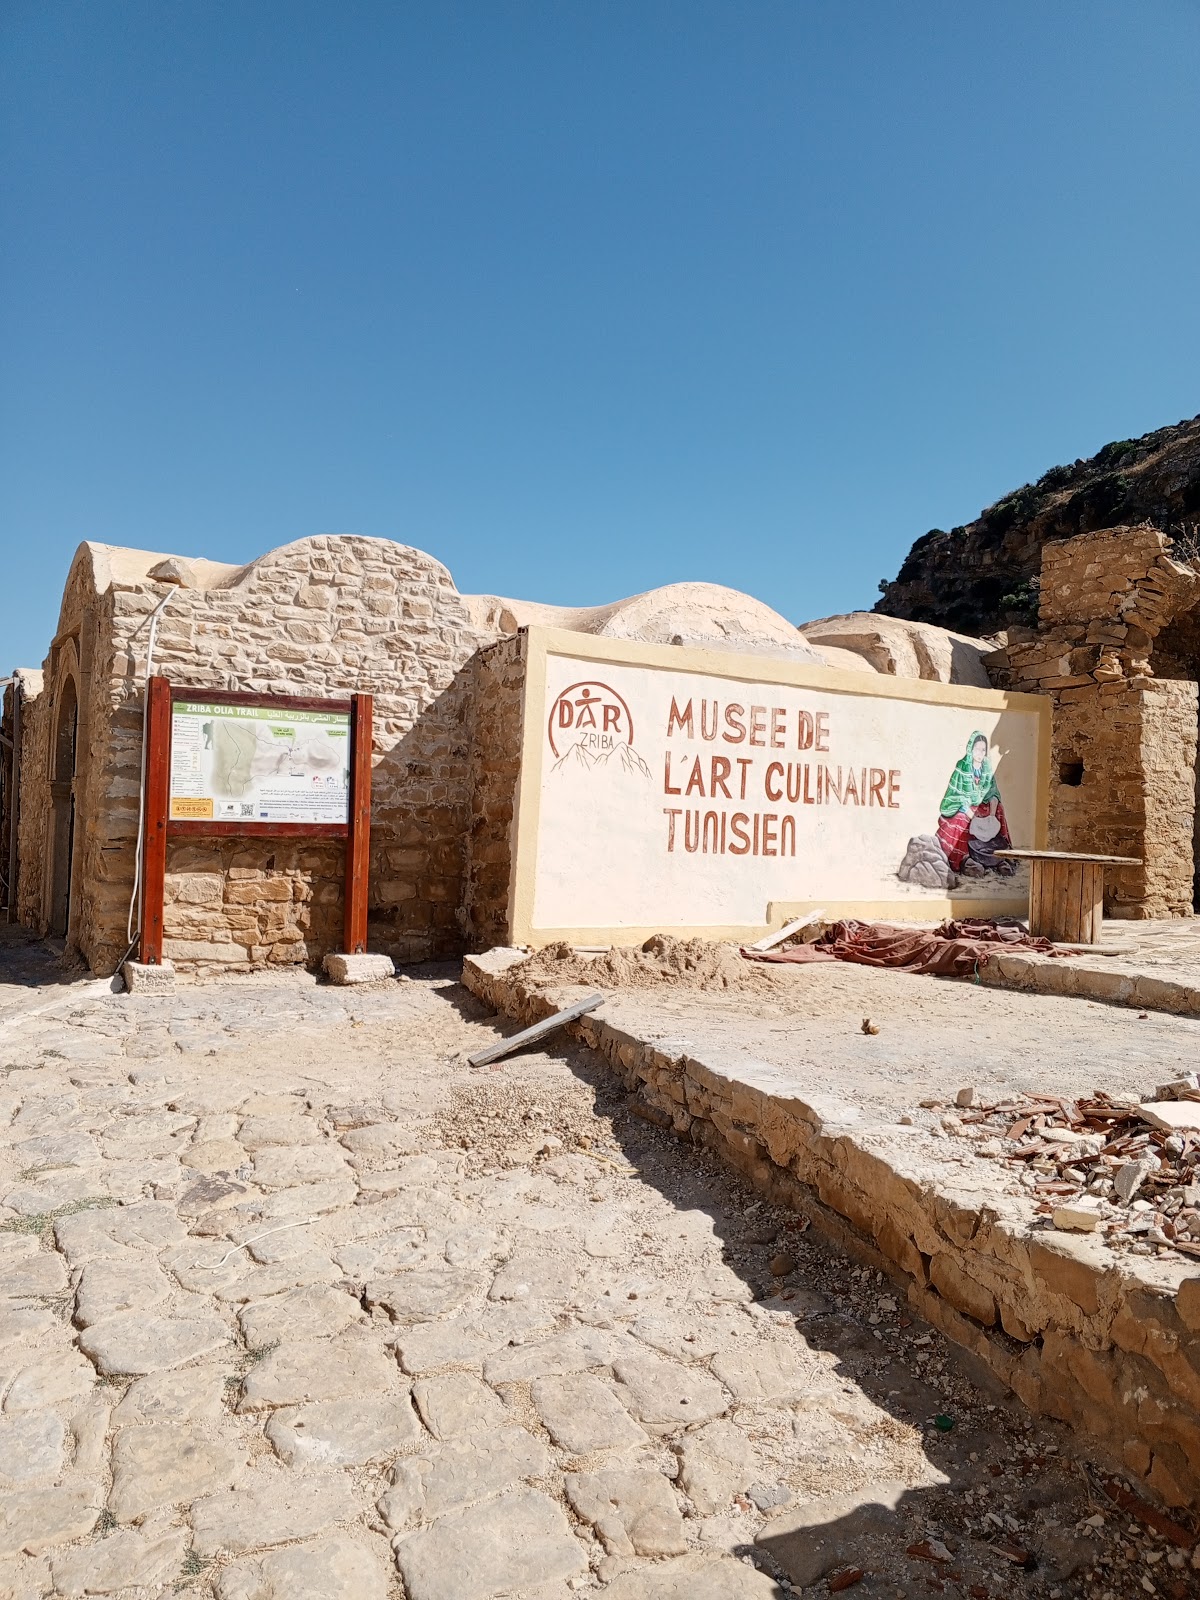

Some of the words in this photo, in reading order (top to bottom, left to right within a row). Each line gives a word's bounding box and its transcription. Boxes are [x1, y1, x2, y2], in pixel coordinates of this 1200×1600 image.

[186, 704, 212, 714] ZRIBA
[213, 705, 234, 715] OLIA
[236, 707, 259, 717] TRAIL
[559, 697, 621, 733] DAR
[666, 695, 786, 749] MUSEE
[797, 710, 830, 752] DE
[580, 731, 615, 750] ZRIBA
[664, 750, 754, 800] L'ART
[764, 761, 902, 809] CULINAIRE
[663, 808, 797, 857] TUNISIEN
